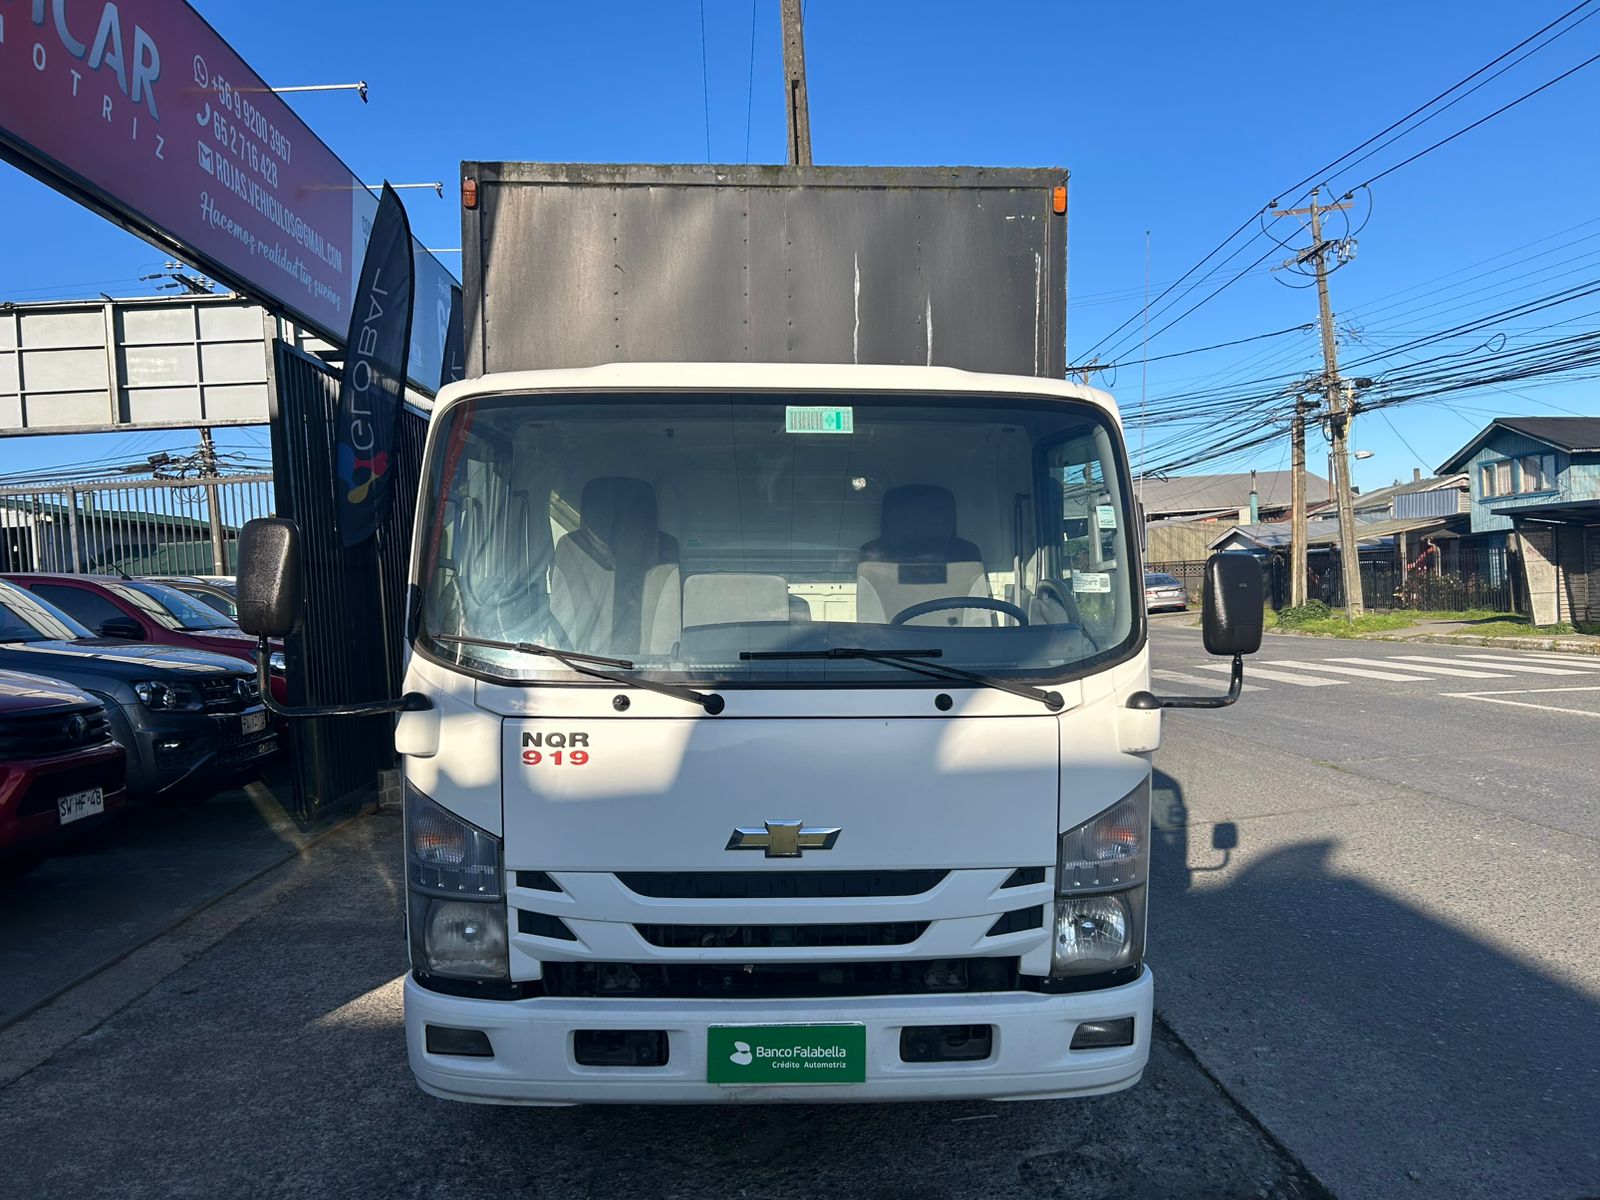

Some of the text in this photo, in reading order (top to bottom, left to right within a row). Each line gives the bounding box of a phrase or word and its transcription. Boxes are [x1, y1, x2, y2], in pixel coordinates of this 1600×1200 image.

[0, 14, 165, 160] OTRIZ
[32, 0, 160, 121] CAR
[211, 74, 291, 165] +56 9 9200 3967
[213, 111, 278, 189] 65 2 716 428
[200, 191, 342, 312] Hacemos realidad tus sueños
[216, 152, 343, 273] ROJAS.VEHICULOS@GMAIL.COM
[522, 732, 589, 749] NQR
[522, 750, 589, 766] 919
[756, 1046, 847, 1058] Banco Falabella
[772, 1061, 847, 1069] Crédito Automotriz
